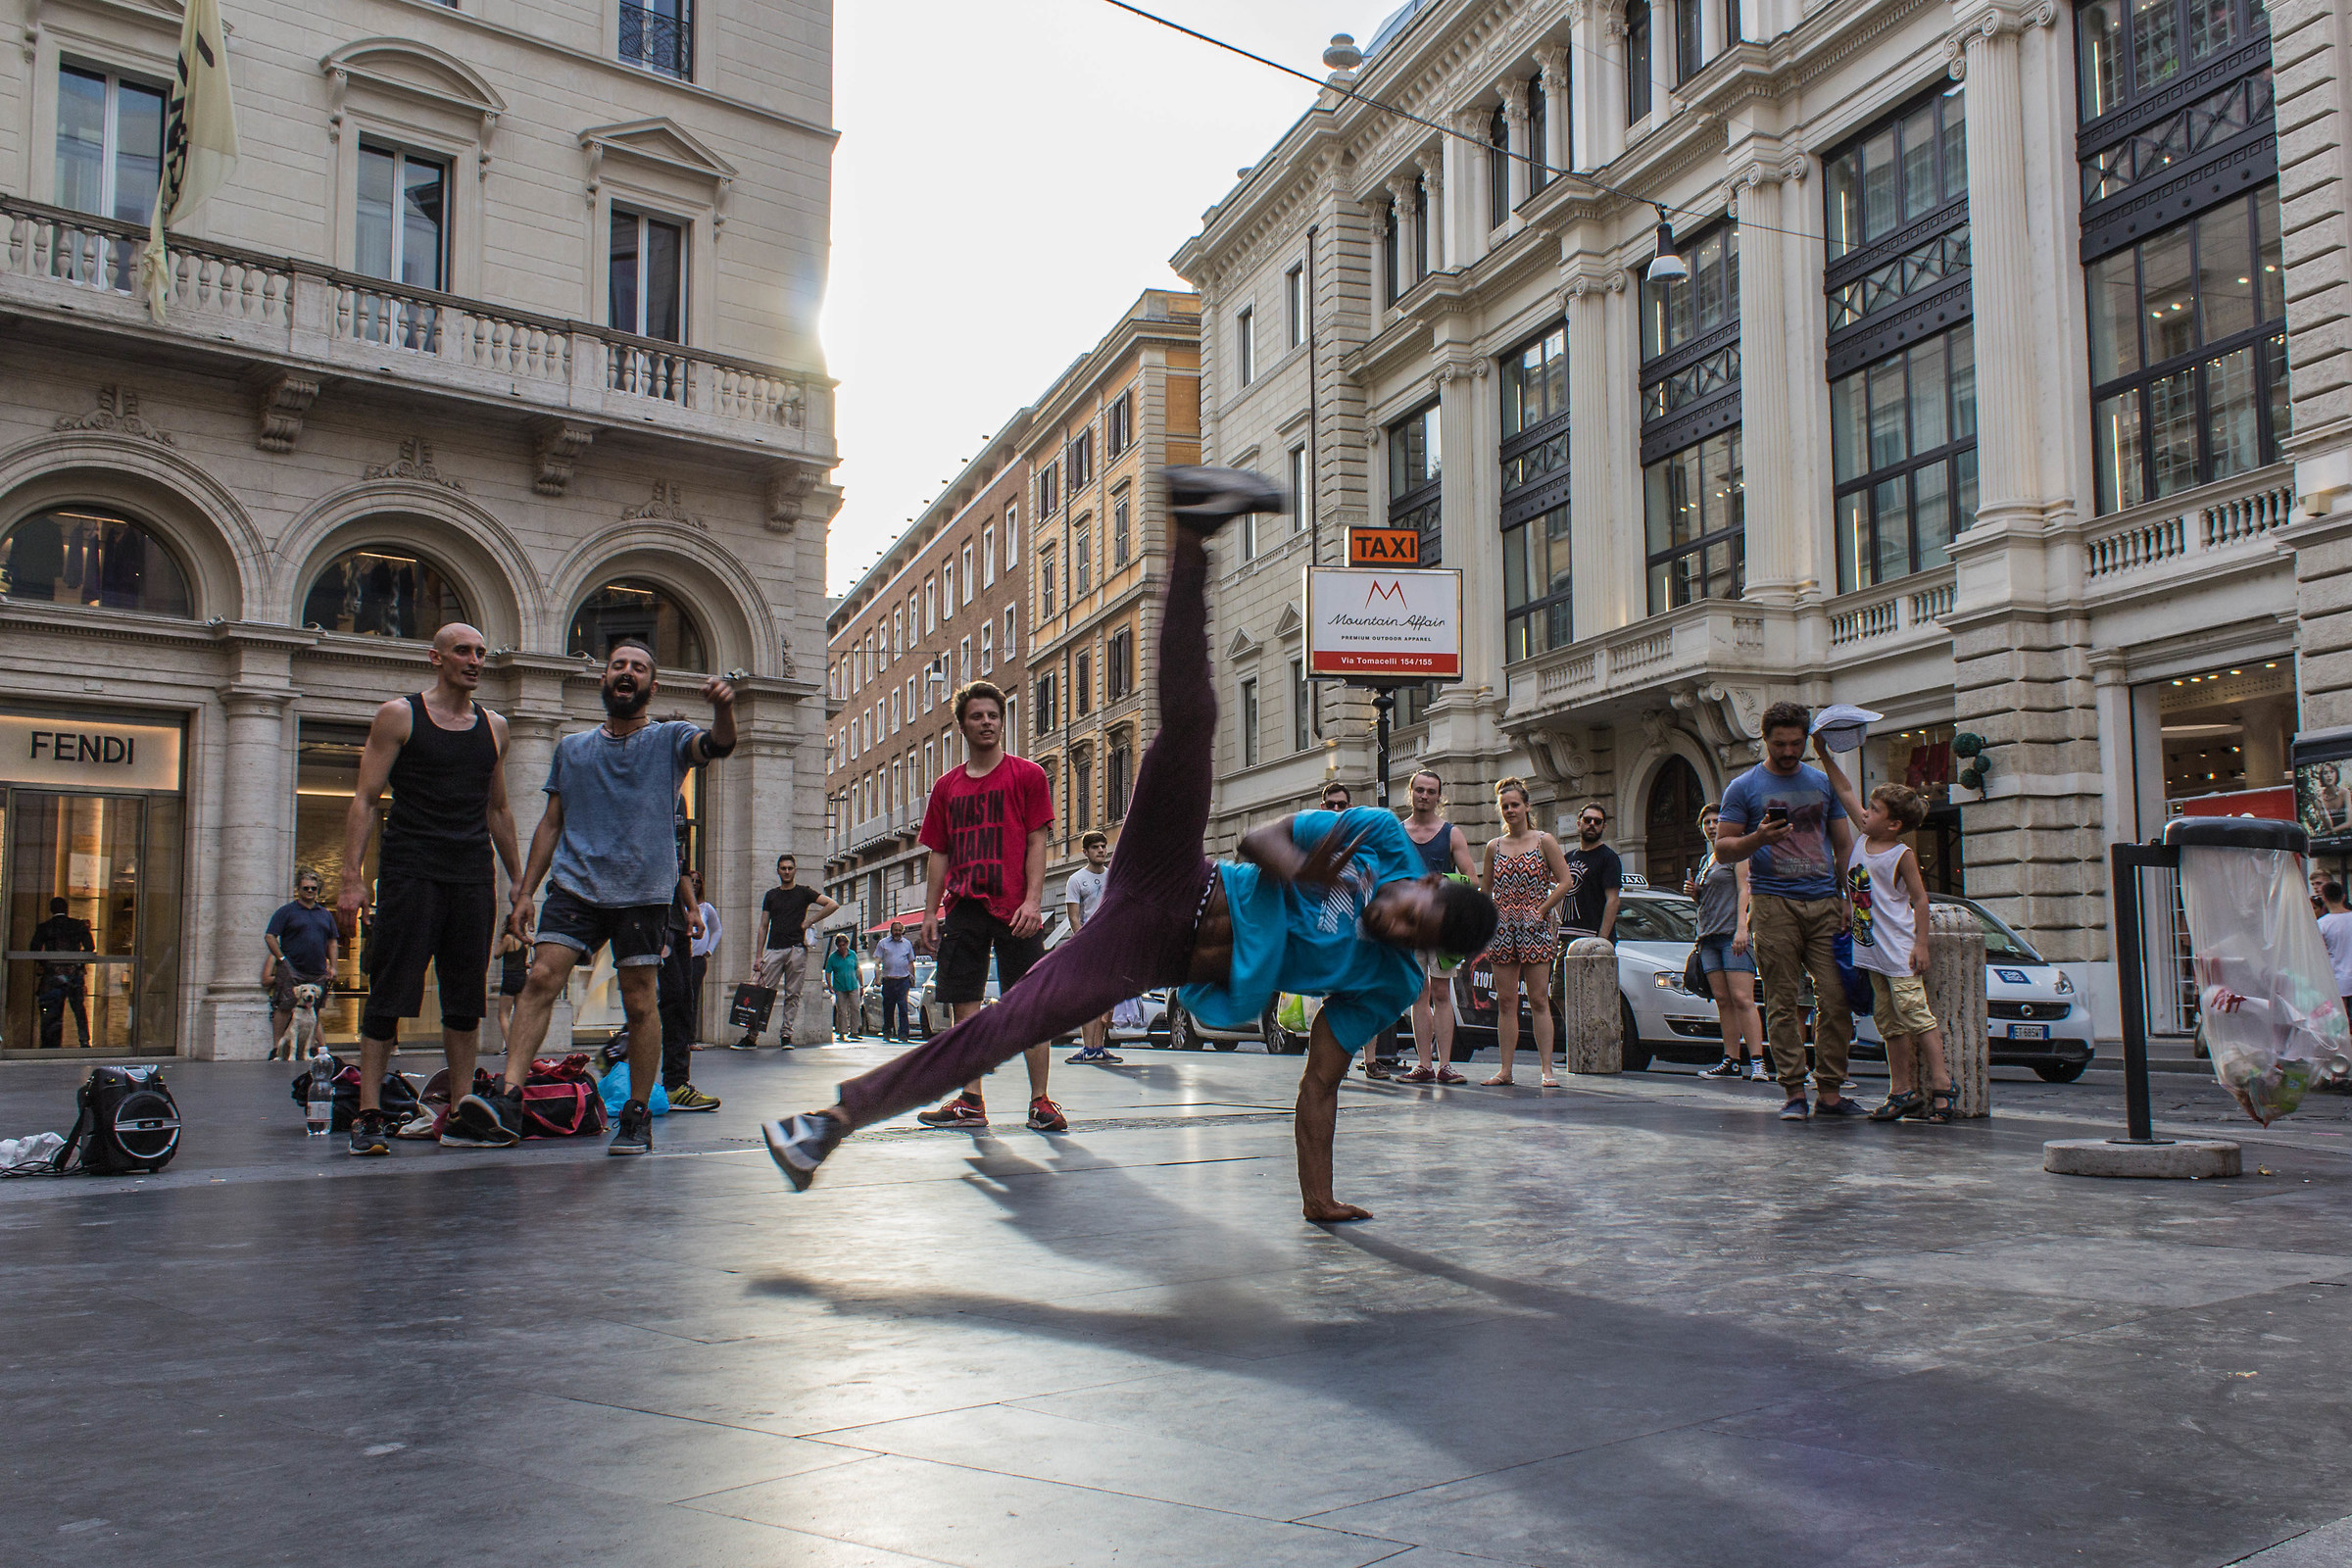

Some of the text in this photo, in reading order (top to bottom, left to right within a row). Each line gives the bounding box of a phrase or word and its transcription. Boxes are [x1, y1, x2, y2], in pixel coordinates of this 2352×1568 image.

[1355, 536, 1416, 559] TAXI
[1328, 613, 1446, 630] Mountain Affair
[1356, 657, 1397, 665] Tomacelli
[30, 731, 134, 764] FENDI
[988, 790, 1004, 823] IN
